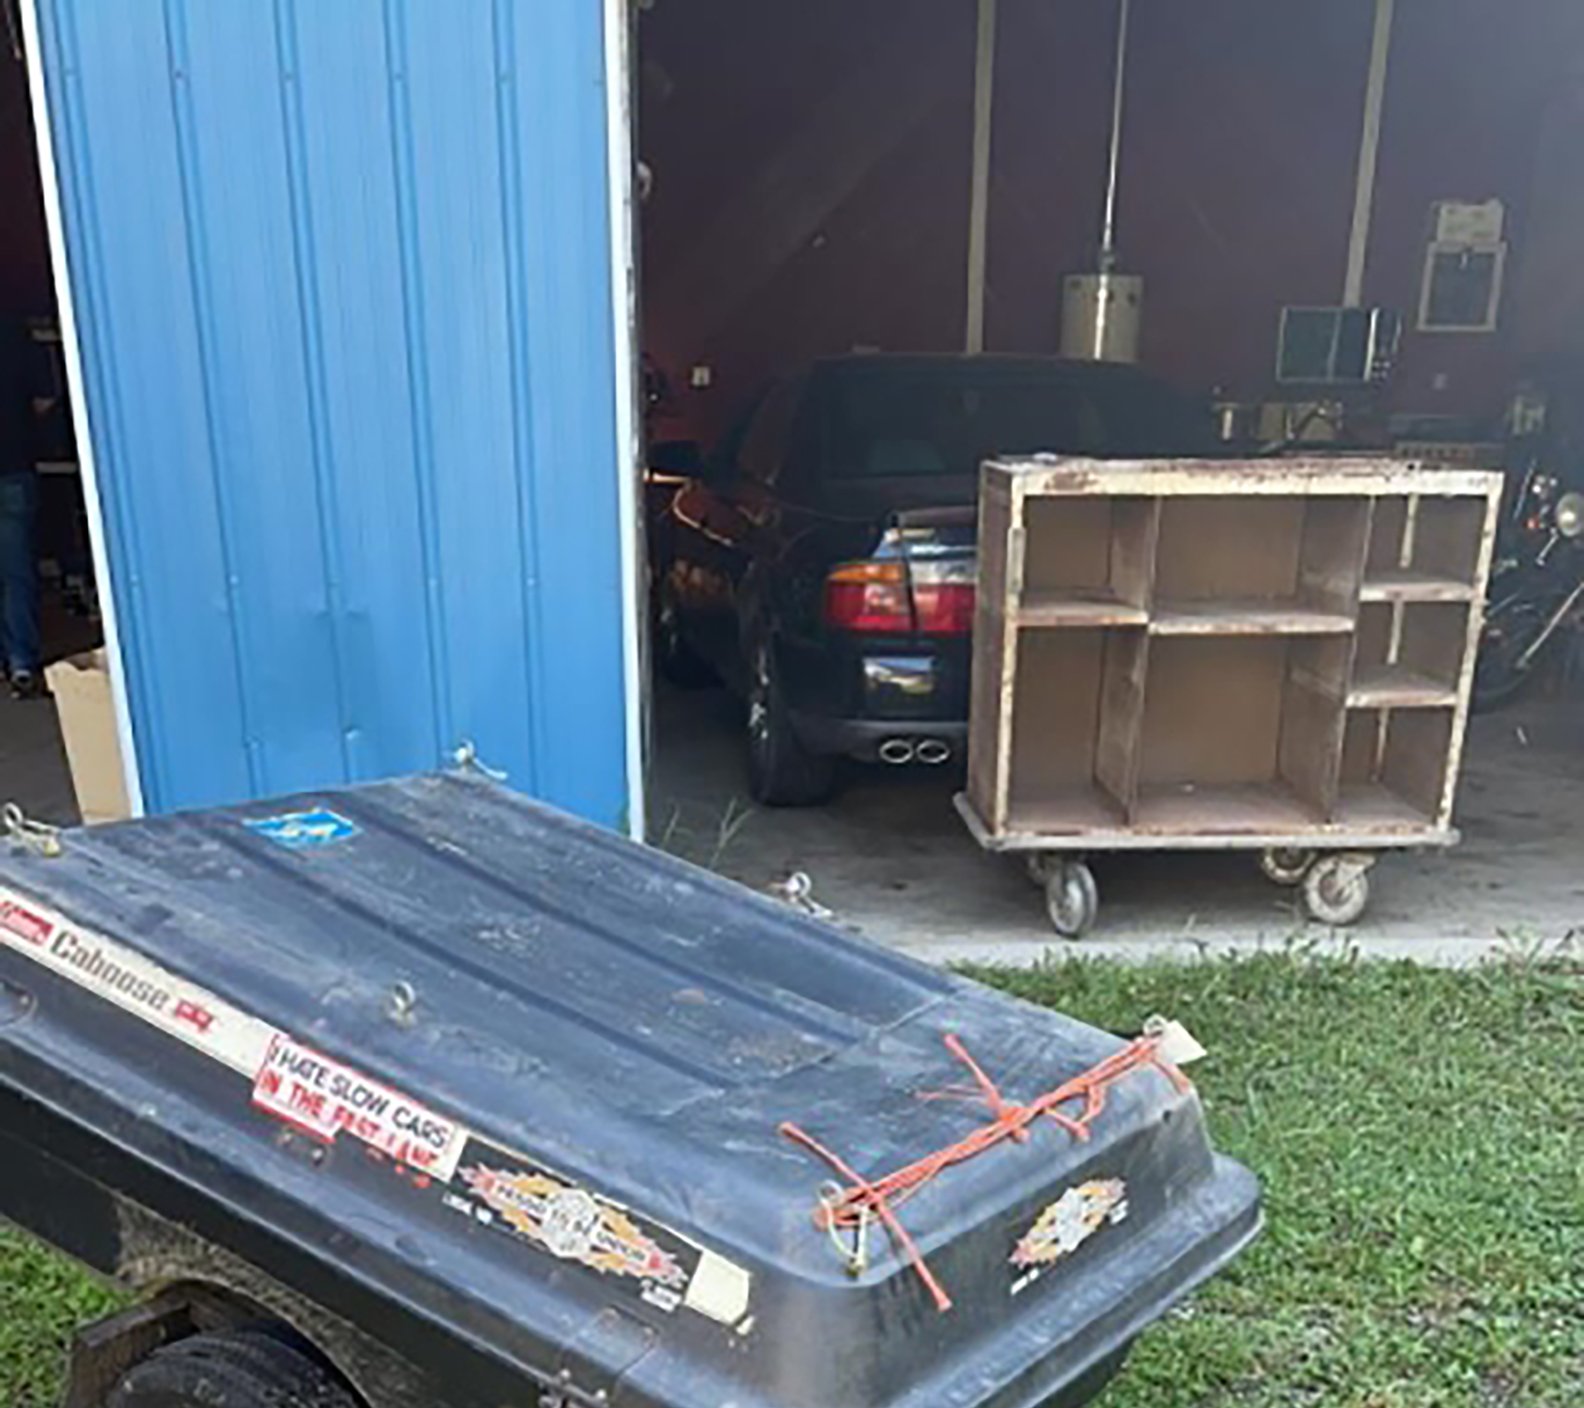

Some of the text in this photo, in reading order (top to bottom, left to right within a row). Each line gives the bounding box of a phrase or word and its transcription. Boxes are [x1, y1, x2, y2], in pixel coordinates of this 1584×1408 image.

[51, 931, 171, 1011] Caboose
[259, 1071, 282, 1094] IN
[289, 1082, 327, 1118] THE
[278, 1049, 330, 1088] HATE
[330, 1072, 389, 1116] SLOW
[392, 1106, 449, 1149] CARS
